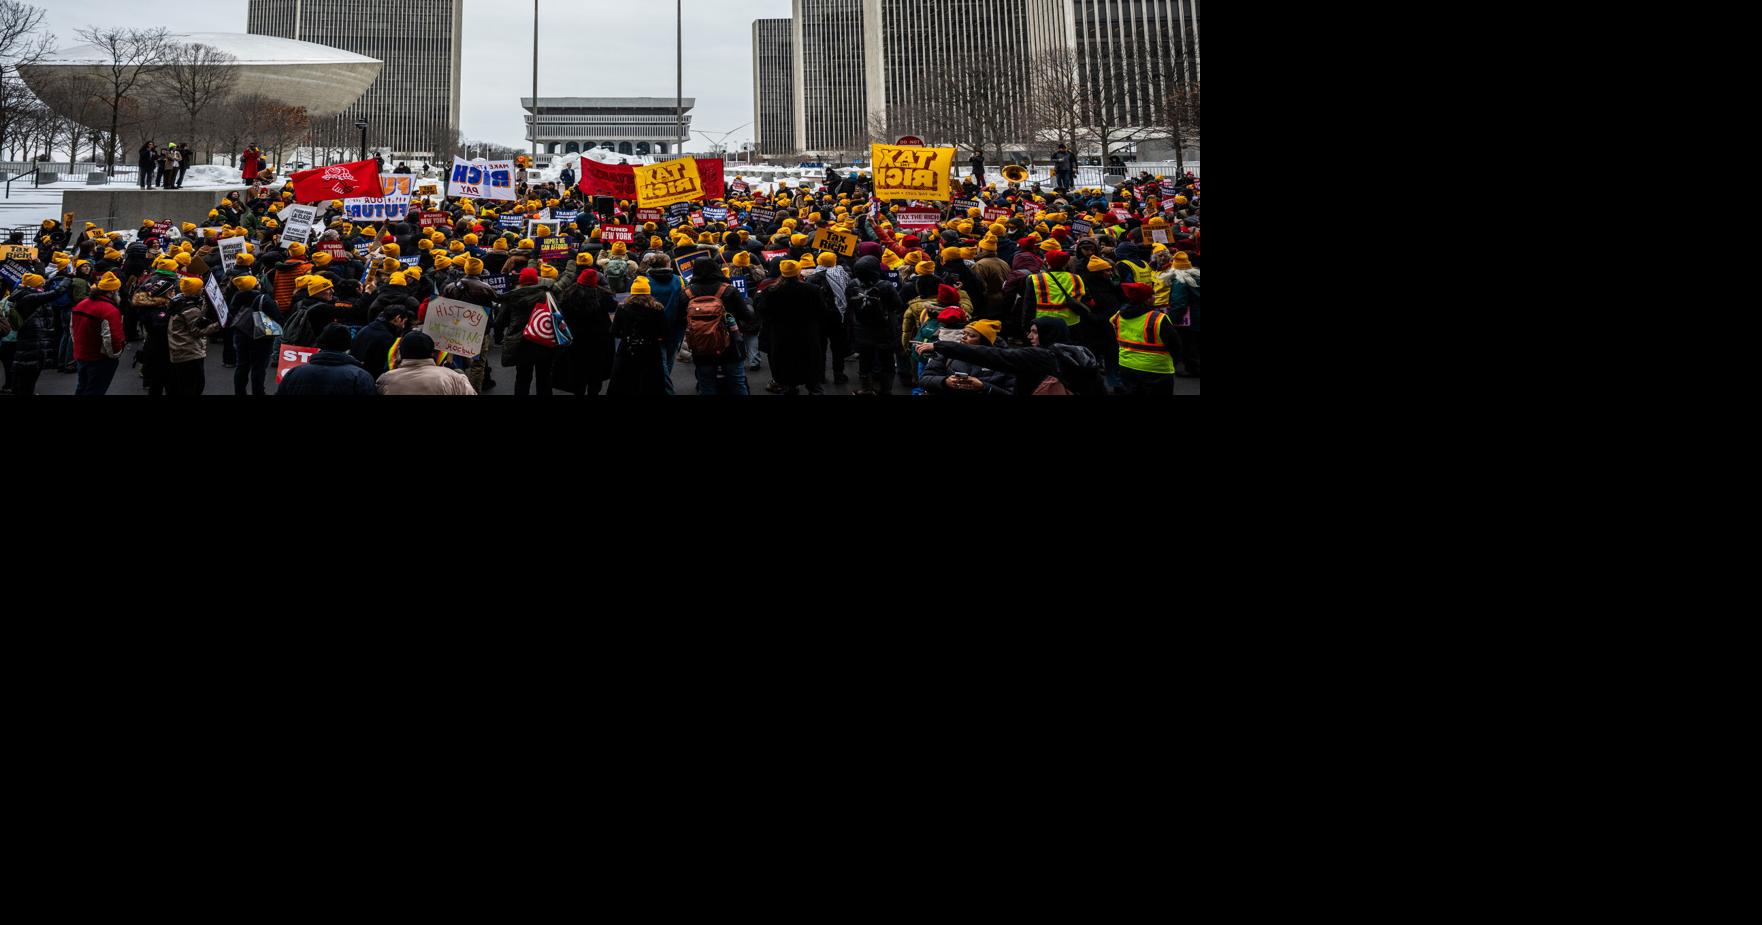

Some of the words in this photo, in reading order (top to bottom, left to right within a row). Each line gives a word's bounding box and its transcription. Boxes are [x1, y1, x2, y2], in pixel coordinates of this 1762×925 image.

[601, 231, 614, 240] NEW
[616, 231, 632, 240] YORK
[826, 230, 847, 243] Tax
[820, 239, 848, 253] Rich!
[283, 350, 312, 363] ST
